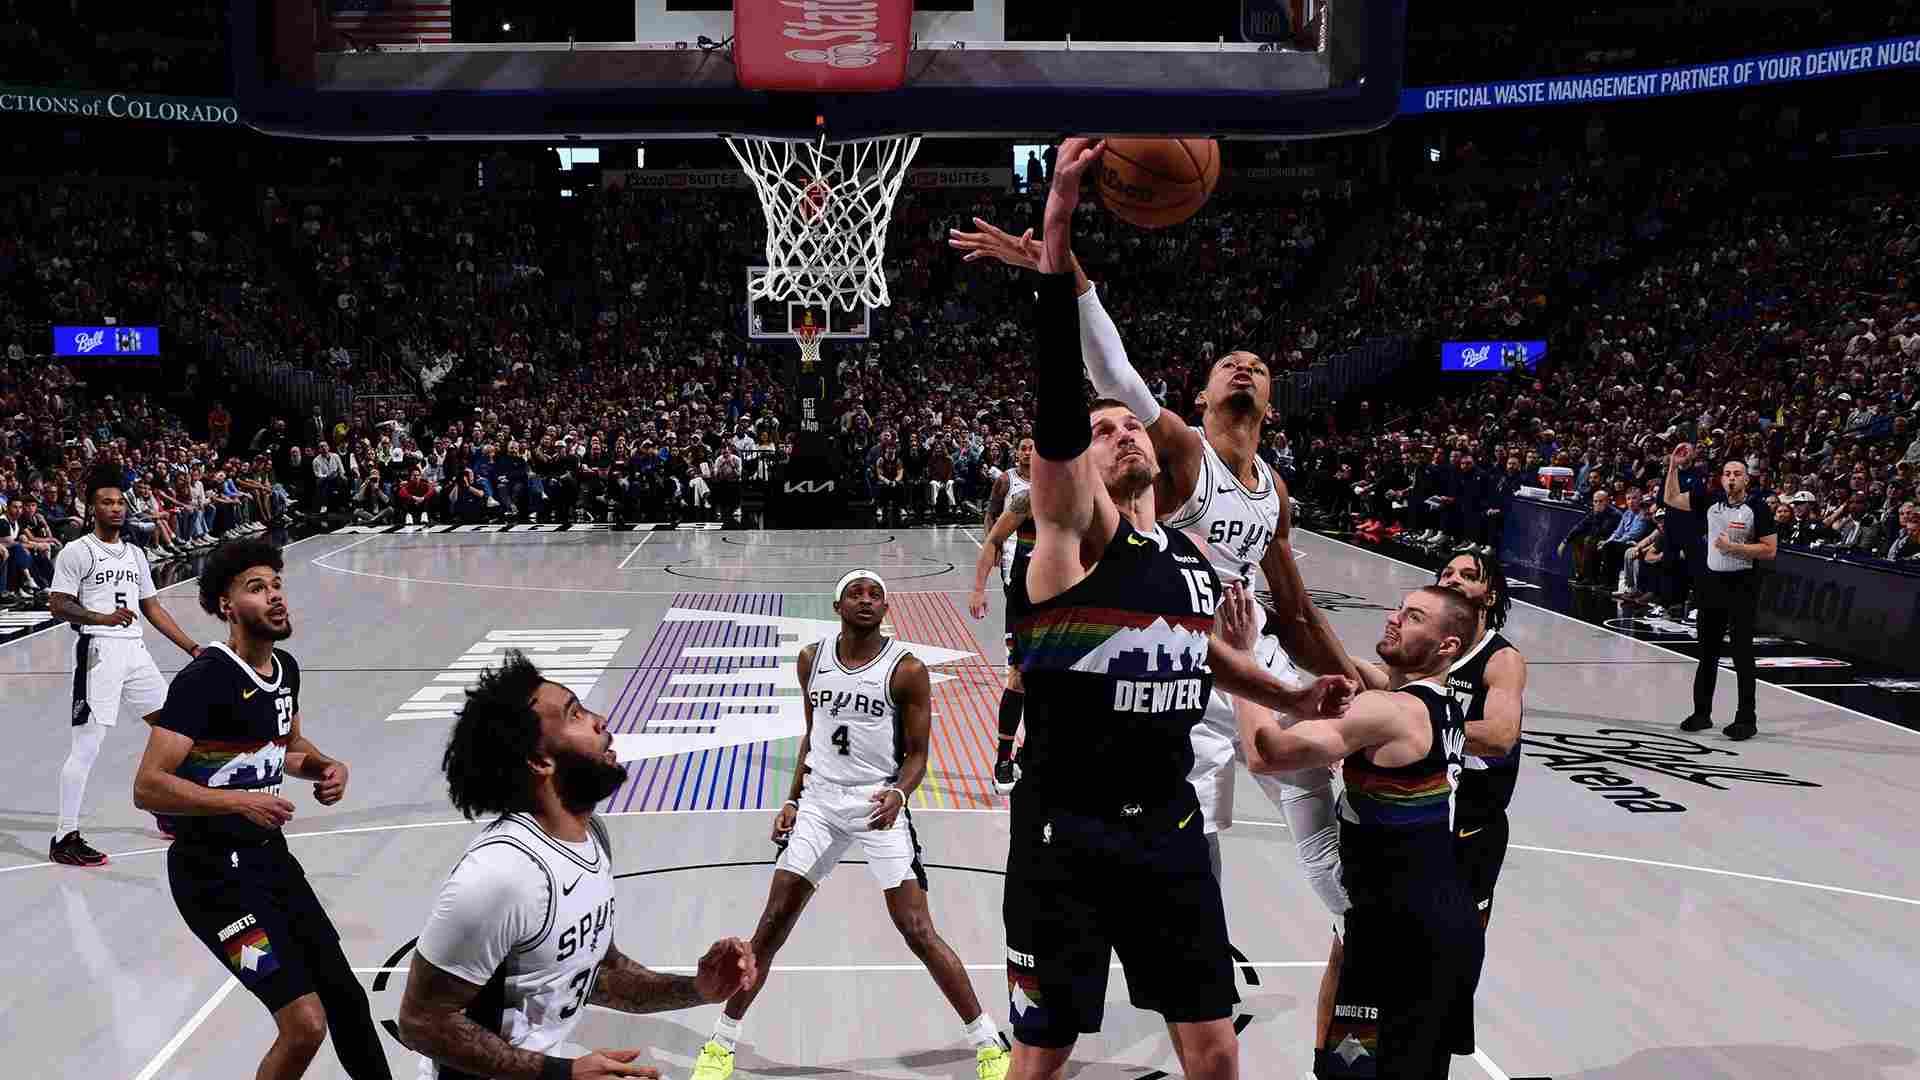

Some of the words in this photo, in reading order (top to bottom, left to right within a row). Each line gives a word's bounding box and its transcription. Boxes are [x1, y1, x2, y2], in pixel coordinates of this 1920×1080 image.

[1425, 87, 1491, 109] OFFICIAL
[1494, 82, 1545, 104] WASTE
[1549, 73, 1658, 101] MANAGEMENT
[1661, 65, 1729, 92] PARTNER
[1733, 61, 1754, 84] OF
[1758, 56, 1801, 80] YOUR
[1806, 46, 1872, 76] DENVER
[0, 94, 79, 113] CTIONS
[83, 101, 102, 116] of
[107, 94, 238, 124] COLORADO
[74, 330, 104, 353] Ball
[1462, 345, 1490, 368] Ball
[802, 397, 816, 408] GET
[803, 408, 816, 419] THE
[1207, 520, 1272, 557] SPUR
[115, 592, 127, 610] 5
[1180, 568, 1215, 616] 15
[810, 690, 885, 718] SPURS
[1113, 679, 1203, 713] DENVER
[275, 696, 293, 736] 23
[831, 725, 850, 756] 4
[1524, 752, 1688, 813] Arena
[556, 897, 615, 962] SPUR
[1335, 1004, 1379, 1020] NUGGETS
